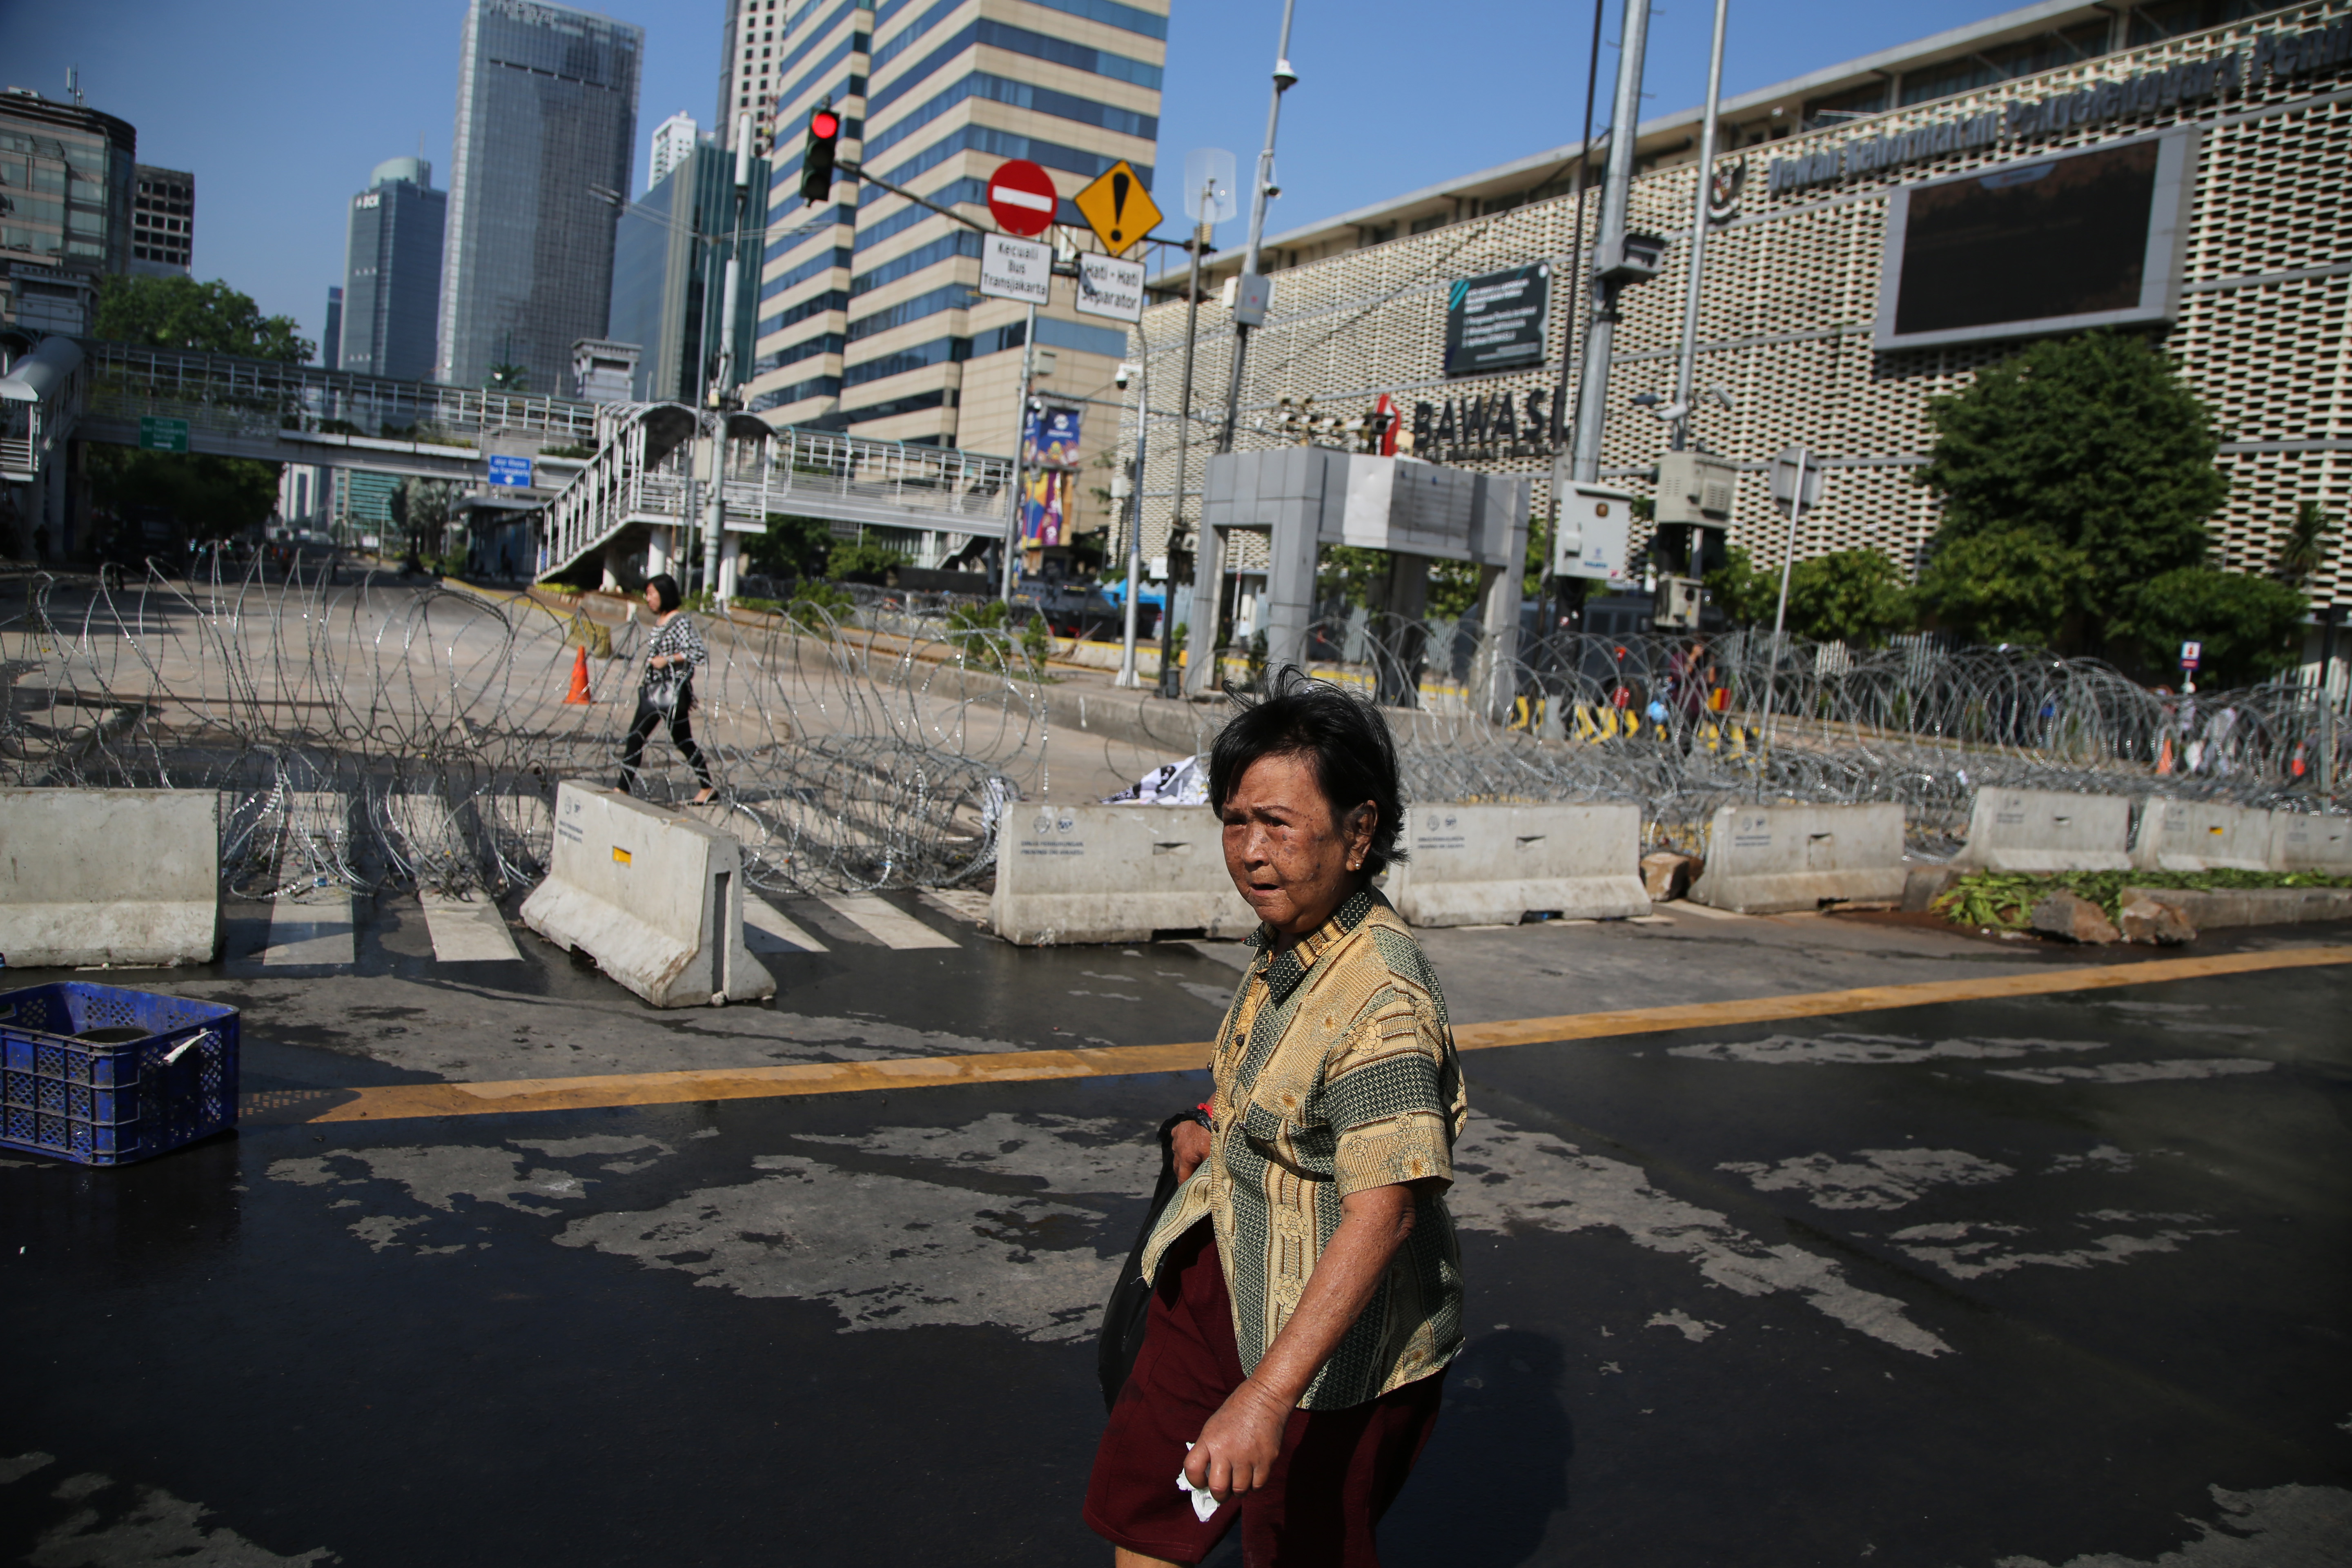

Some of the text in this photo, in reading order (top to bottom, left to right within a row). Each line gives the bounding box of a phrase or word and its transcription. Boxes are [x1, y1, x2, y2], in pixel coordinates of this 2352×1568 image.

[998, 241, 1039, 260] Kecuali
[1007, 259, 1026, 274] Bus
[1085, 262, 1108, 280] Hati
[1117, 268, 1140, 287] Hati
[982, 273, 1047, 295] Transjakarta
